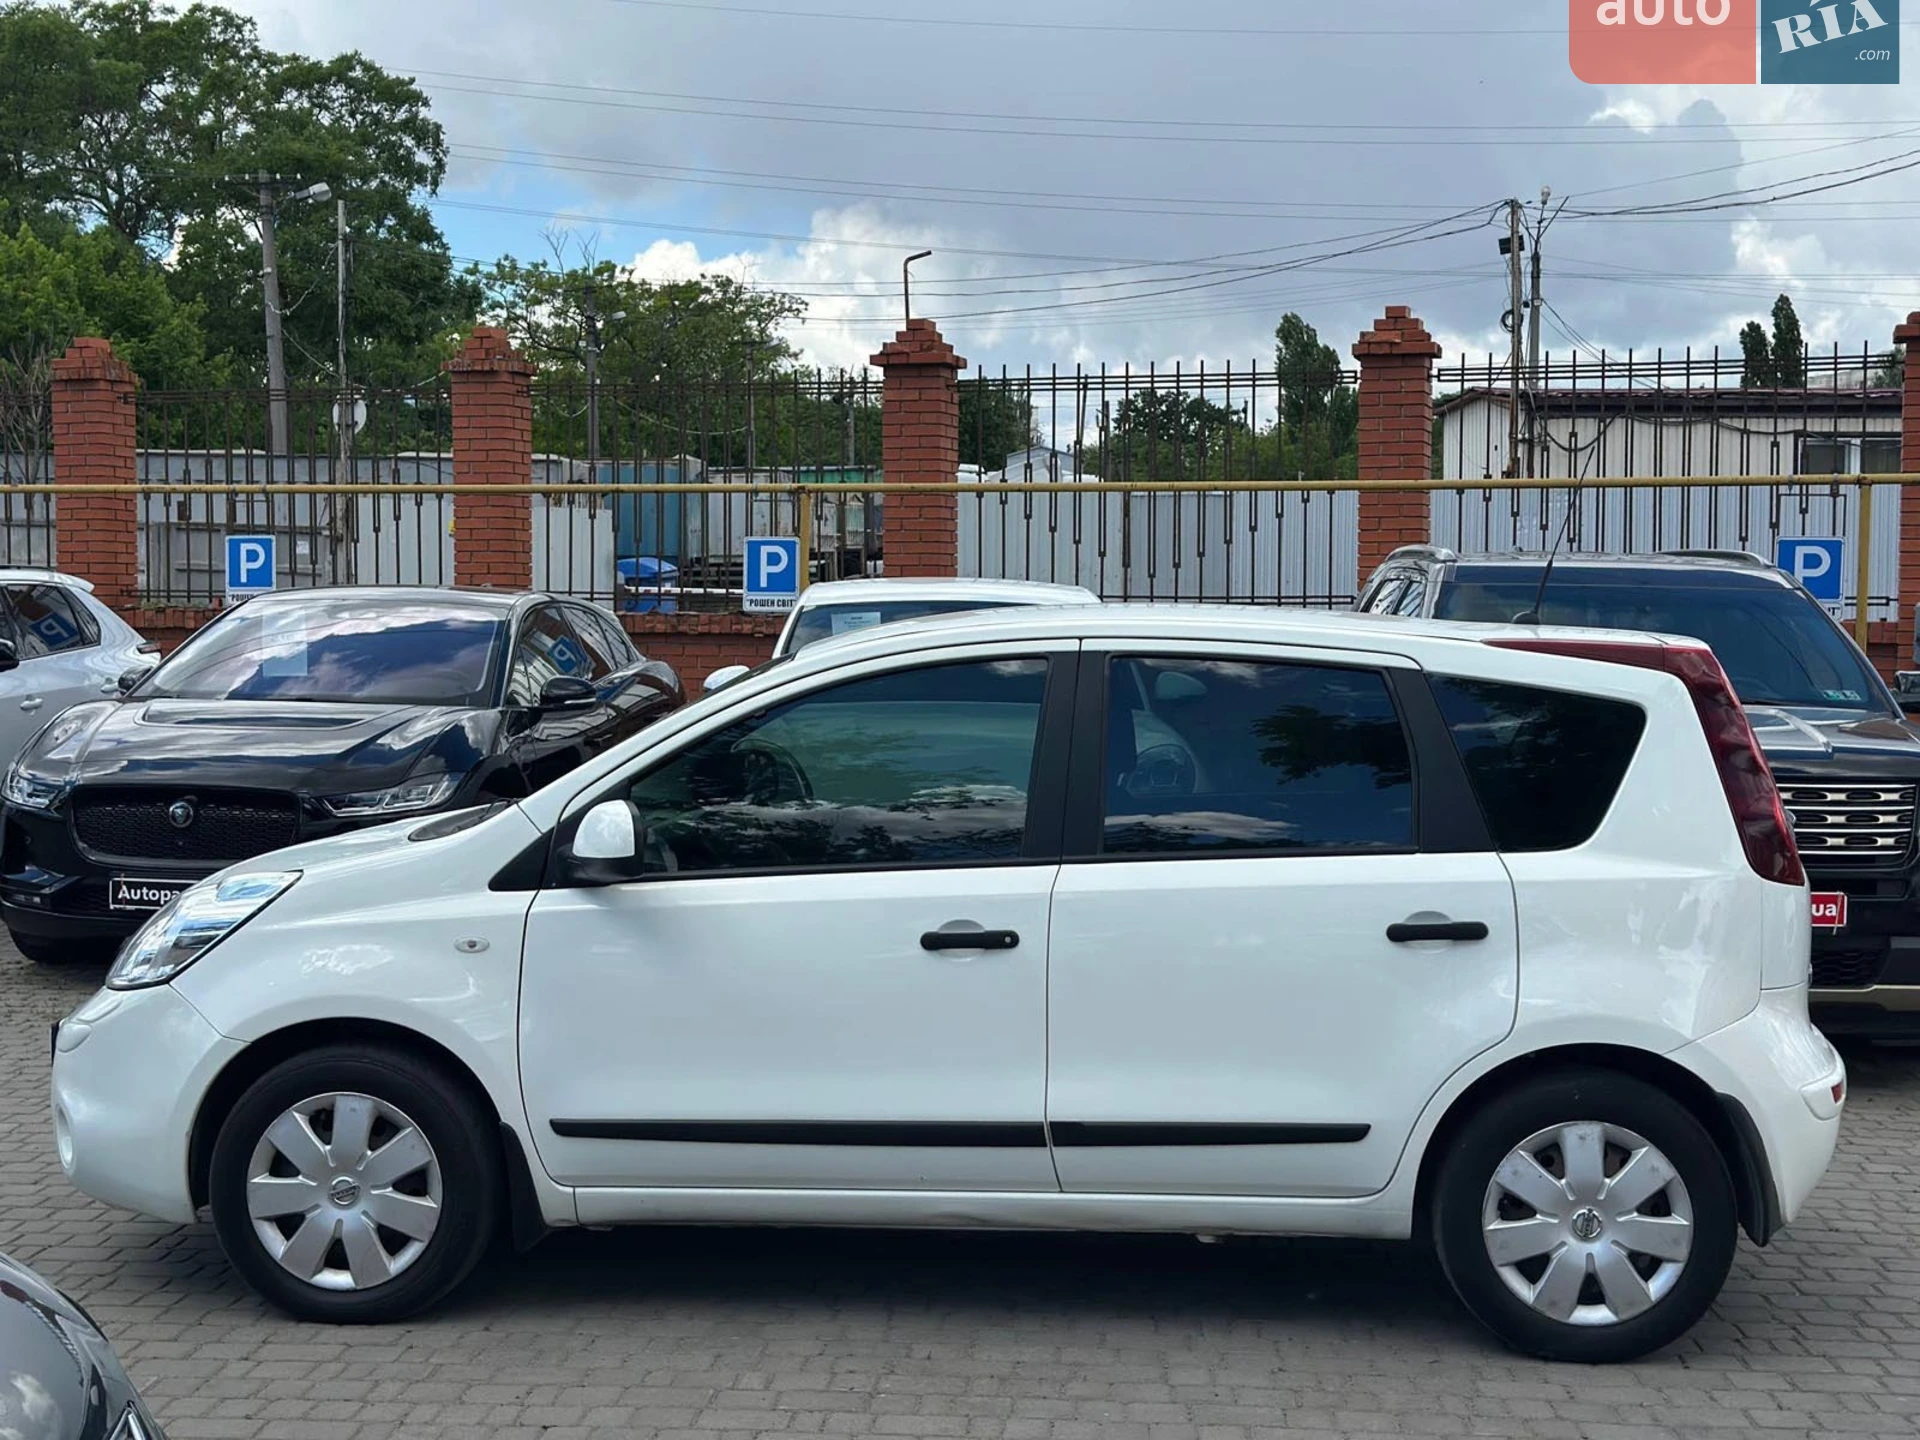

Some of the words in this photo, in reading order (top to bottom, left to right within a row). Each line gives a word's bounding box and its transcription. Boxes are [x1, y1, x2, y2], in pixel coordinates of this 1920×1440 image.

[240, 543, 265, 583] P
[760, 545, 788, 588] P
[1794, 545, 1831, 584] P
